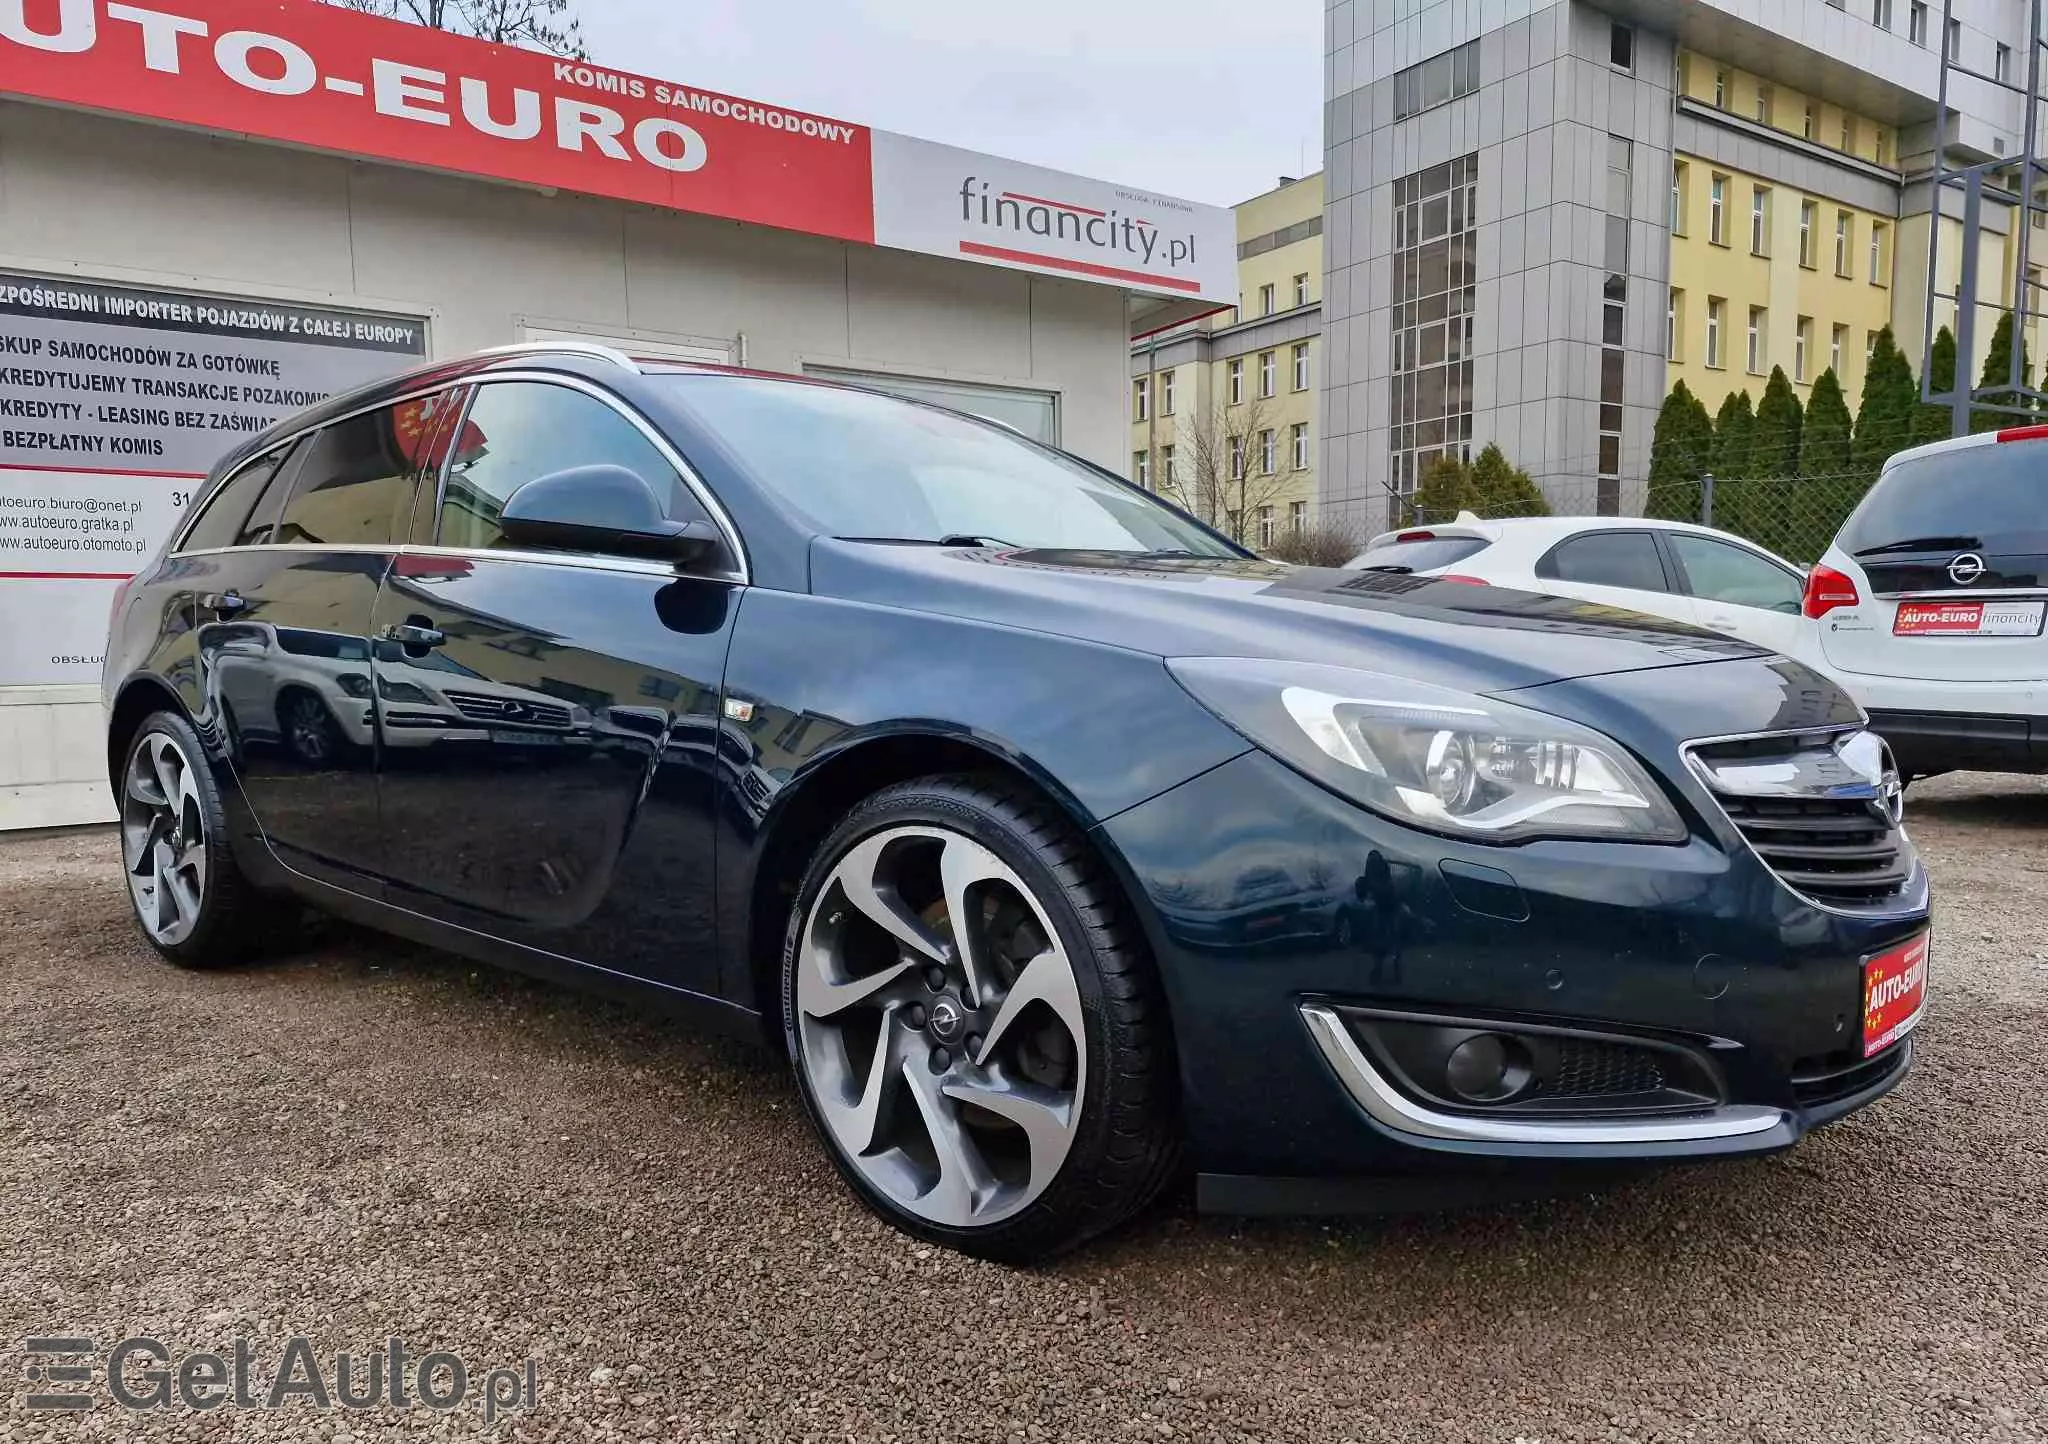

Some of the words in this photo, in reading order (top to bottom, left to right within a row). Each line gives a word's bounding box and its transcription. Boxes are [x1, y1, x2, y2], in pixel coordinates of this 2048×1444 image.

[555, 63, 646, 100] KOMIS
[654, 84, 855, 146] SAMOCHODOWY
[960, 176, 1196, 267] financity.pl
[105, 296, 193, 323] IMPORTER
[197, 307, 284, 332] POJAZDÓW
[289, 317, 299, 333] Z
[303, 319, 350, 338] CAŁEJ
[355, 323, 413, 345] EUROPY
[48, 339, 171, 367] SAMOCHODÓW
[176, 351, 198, 369] ZA
[202, 353, 281, 381] GOTÓWKĘ
[0, 367, 126, 393] KREDYTUJEMY
[131, 378, 239, 403] TRANSAKCJE
[0, 399, 82, 421] KREDYTY
[97, 405, 169, 426] LEASING
[174, 411, 206, 429] BEZ
[209, 411, 277, 432] ZAŚWIA
[3, 430, 104, 452] BEZPŁATNY
[110, 436, 164, 456] KOMIS
[1903, 612, 1978, 623] AUTO-EURO
